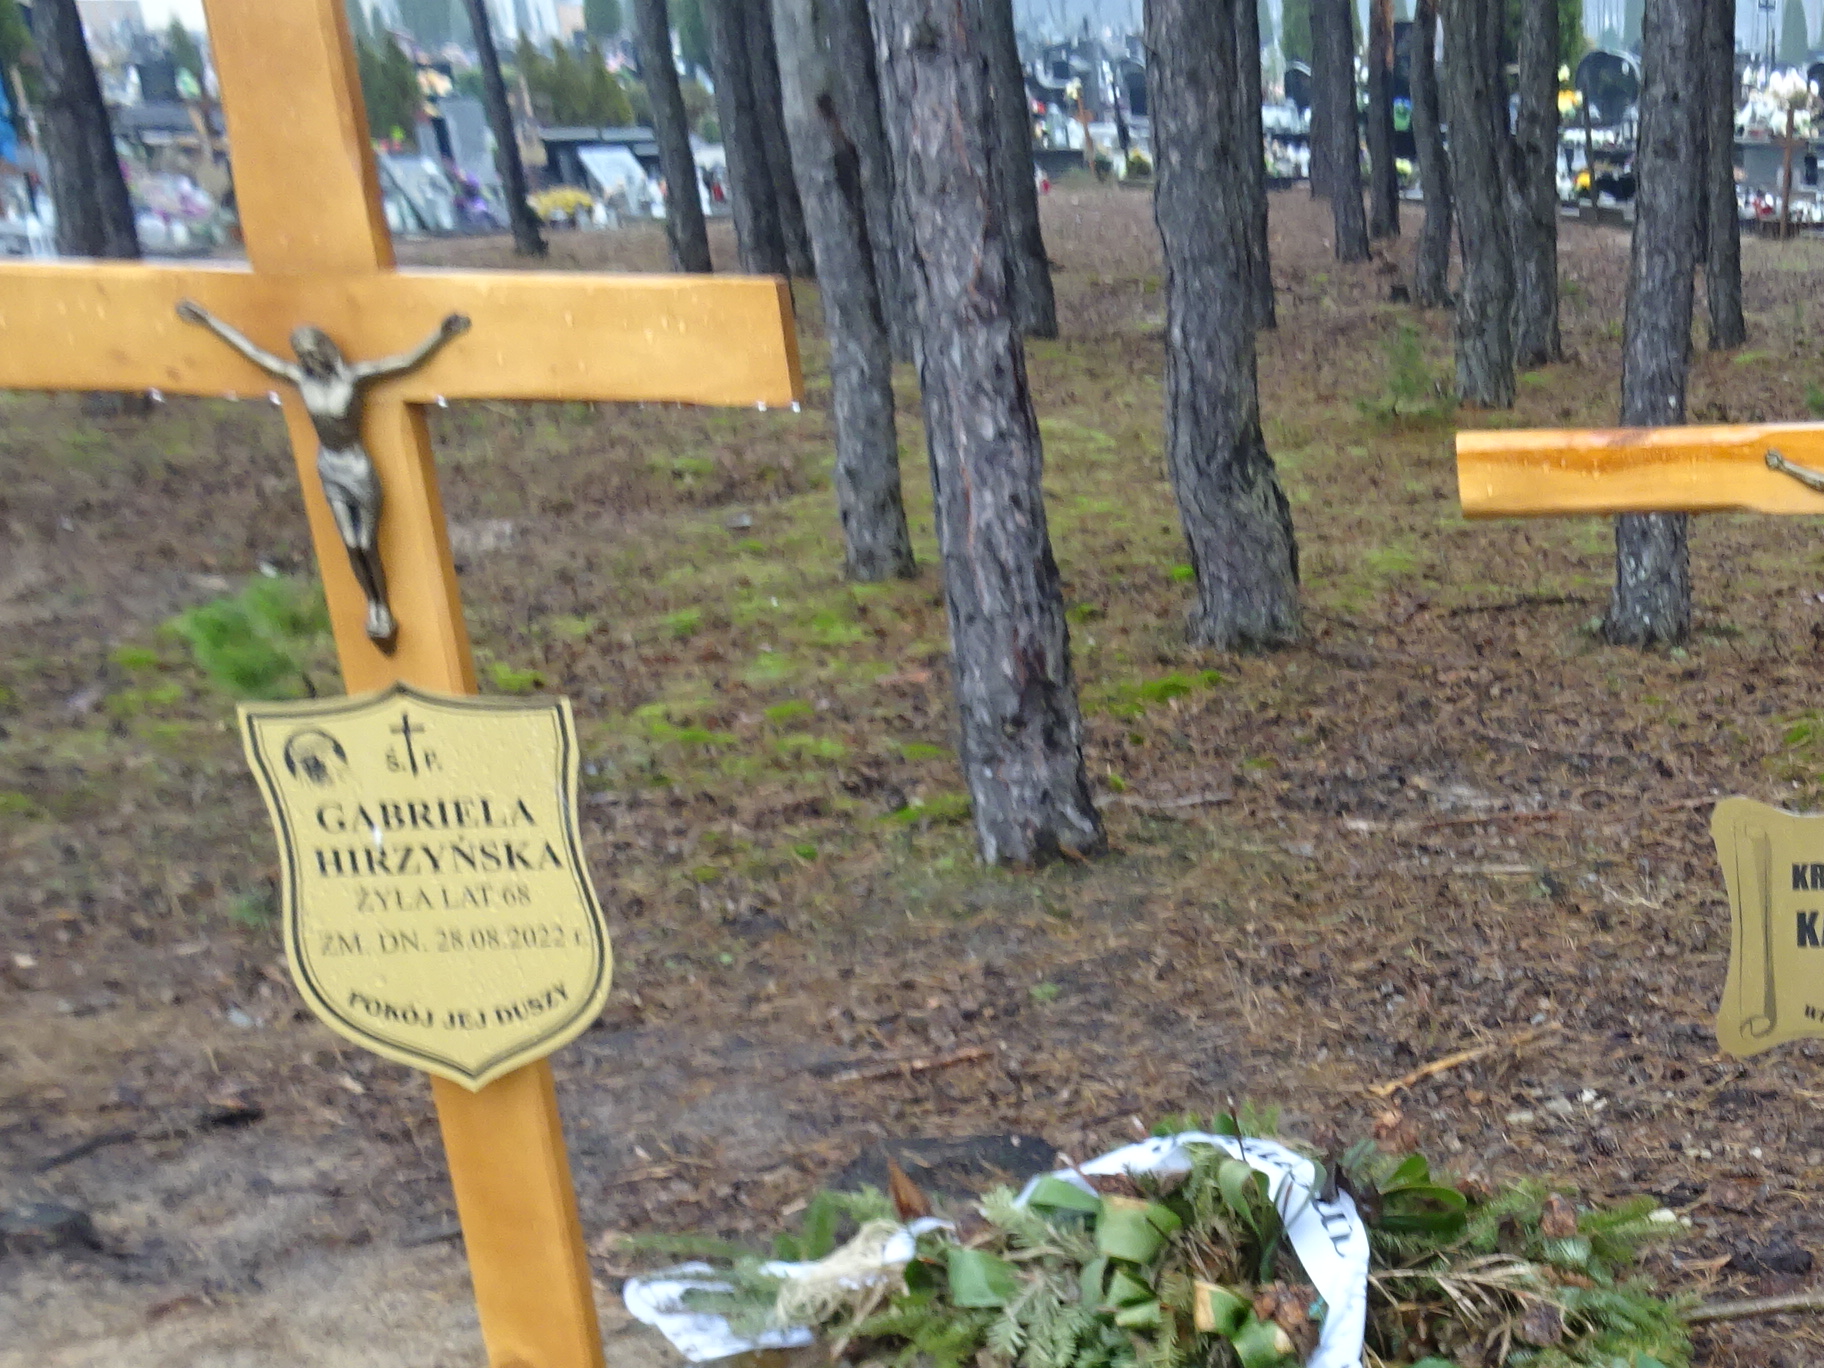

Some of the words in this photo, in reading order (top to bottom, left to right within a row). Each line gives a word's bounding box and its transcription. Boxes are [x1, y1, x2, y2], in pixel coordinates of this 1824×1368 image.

[315, 797, 537, 834] GABRIELA
[314, 834, 564, 878] HIRZYŃSKA
[440, 885, 495, 910] LAT
